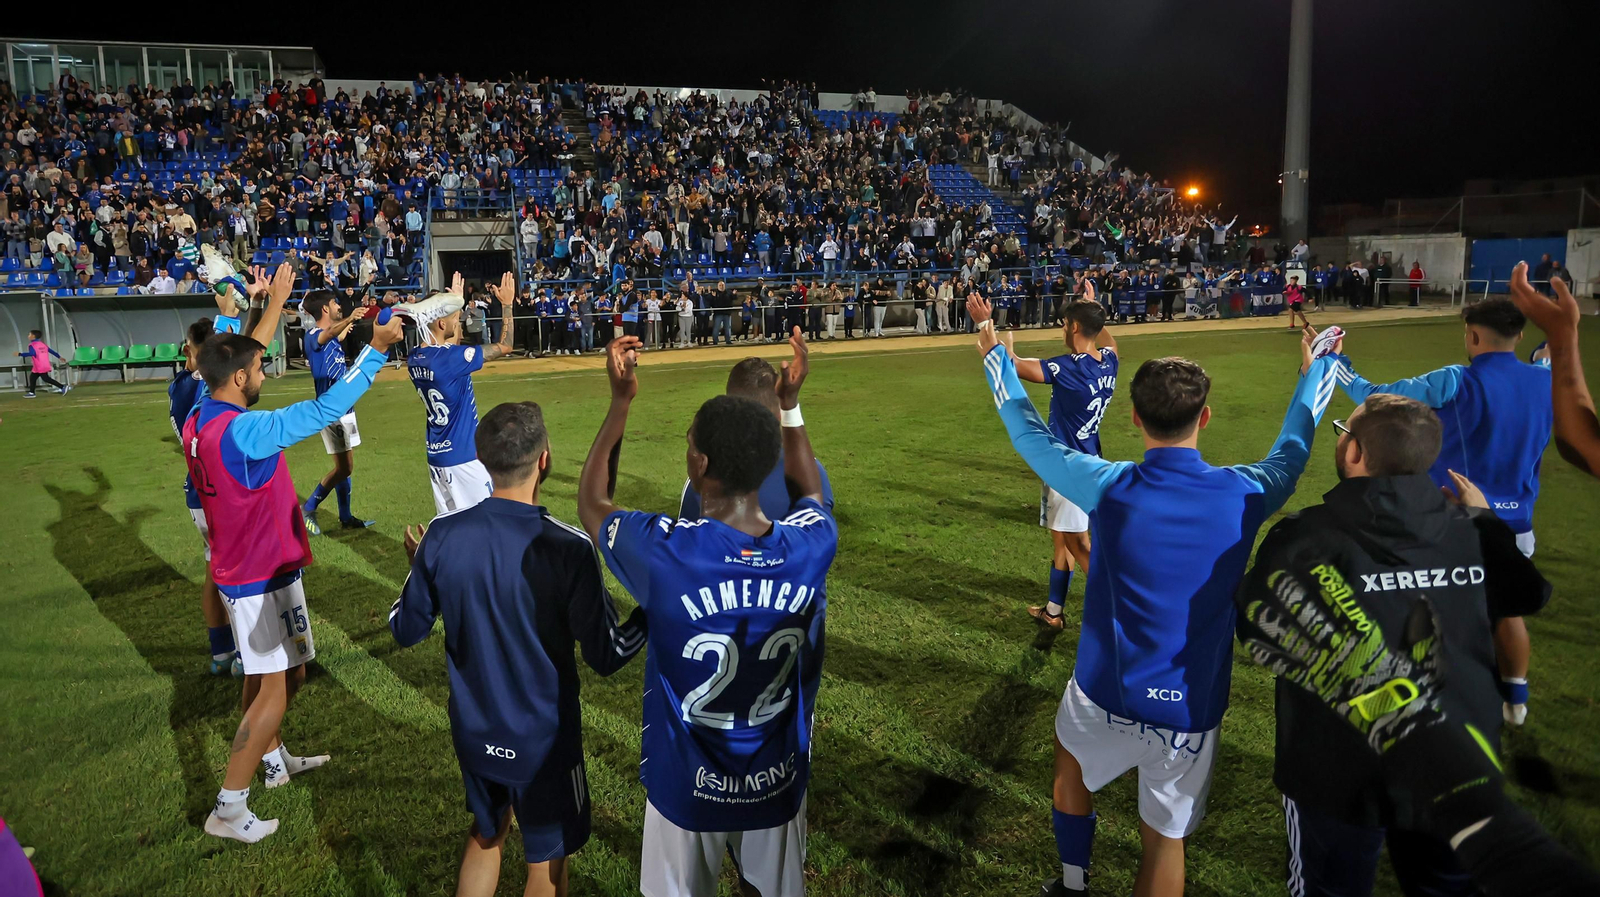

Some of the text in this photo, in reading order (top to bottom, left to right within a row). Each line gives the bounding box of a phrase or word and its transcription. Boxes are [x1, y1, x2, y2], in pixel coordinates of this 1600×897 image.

[1493, 501, 1519, 509] XCD
[1360, 566, 1485, 593] XEREZ CD
[1309, 564, 1373, 632] POSILLIPO
[280, 605, 308, 638] 15
[681, 627, 805, 730] 22
[1146, 687, 1183, 702] XCD
[485, 744, 516, 760] XCD
[693, 789, 726, 804] Empresa
